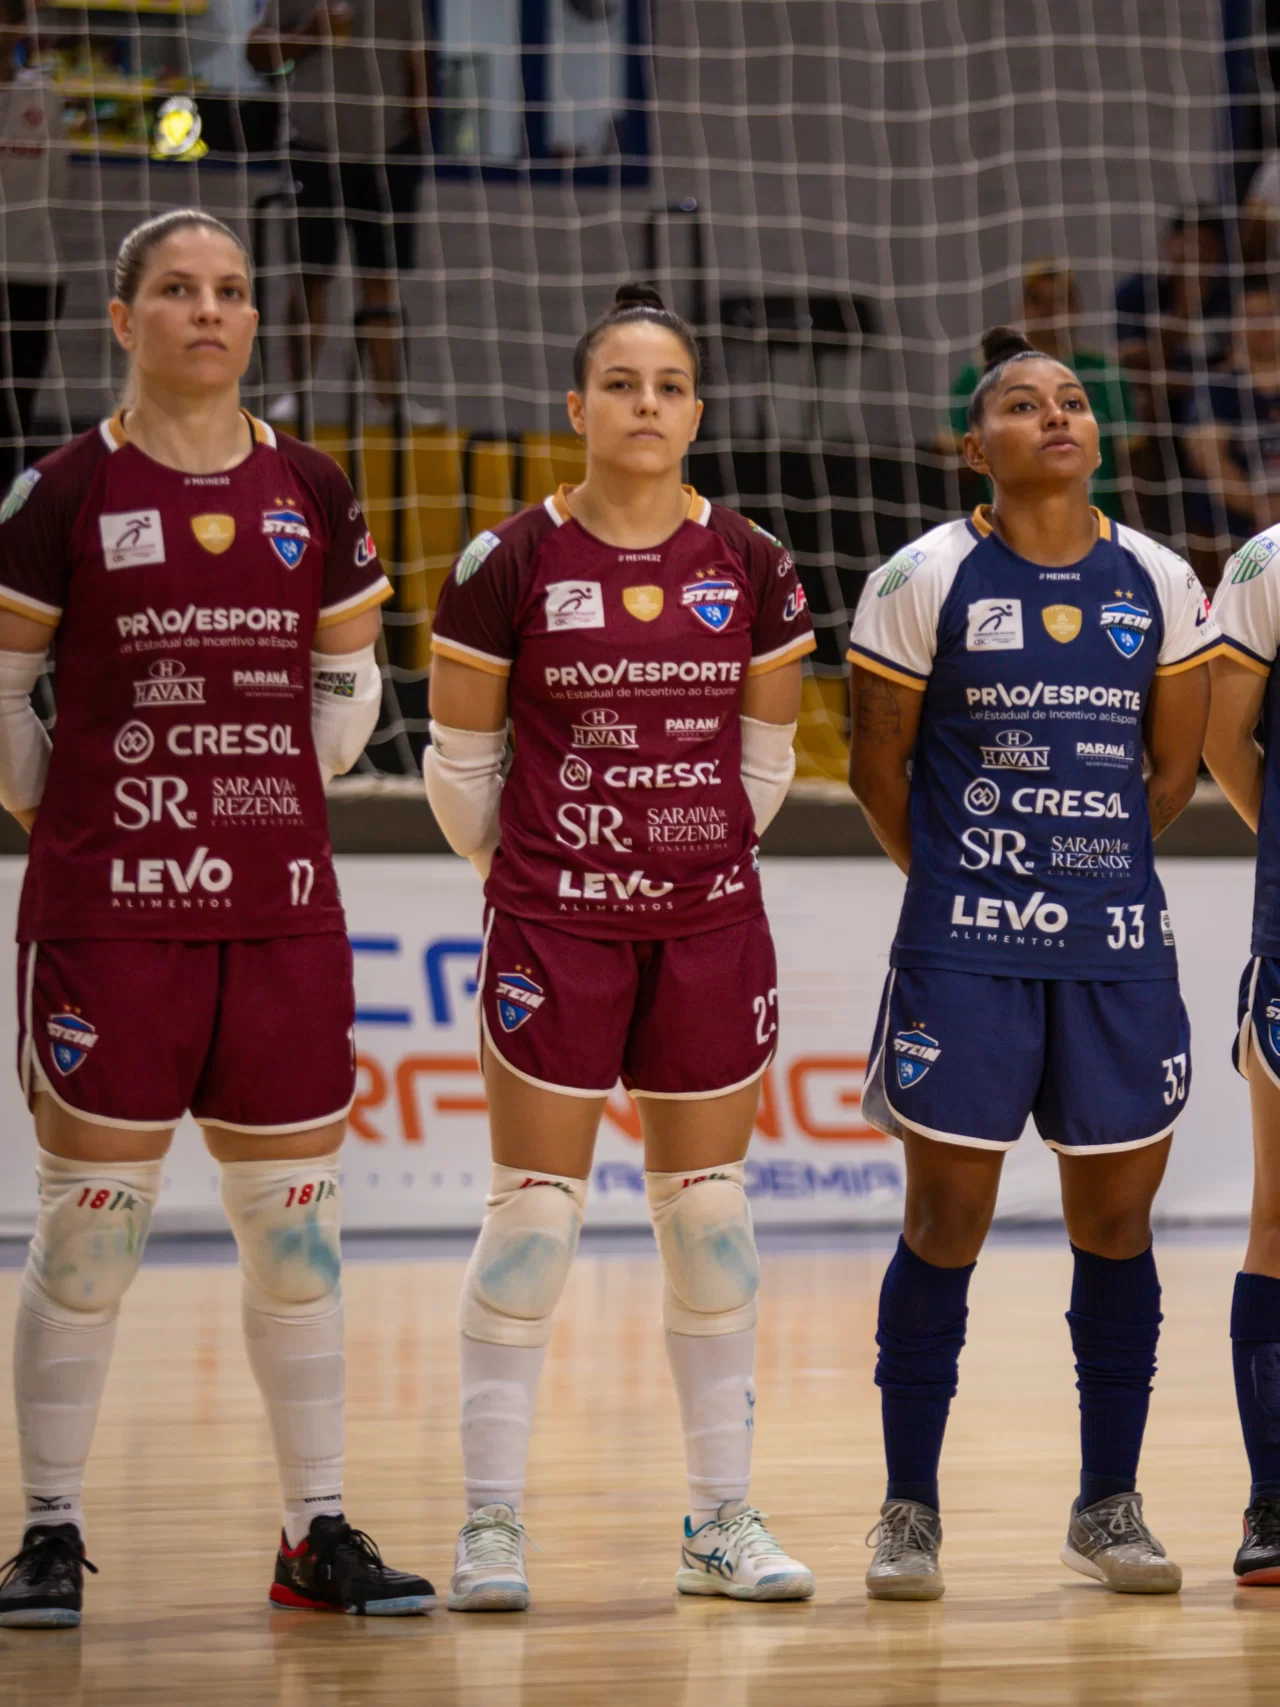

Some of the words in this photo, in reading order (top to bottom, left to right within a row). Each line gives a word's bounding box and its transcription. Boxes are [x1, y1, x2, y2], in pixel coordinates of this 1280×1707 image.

[1046, 573, 1081, 581] MEINERZ
[682, 589, 739, 605] STEIN
[1100, 611, 1152, 631] STEIN
[135, 638, 182, 653] Estadual
[185, 636, 200, 647] de
[203, 635, 255, 647] Incentivo
[269, 636, 299, 650] Espo
[232, 668, 290, 685] PARANÁ
[135, 682, 204, 704] HAVAN
[567, 688, 613, 699] Estadual
[617, 688, 630, 697] de
[633, 686, 685, 697] Incentivo
[688, 688, 702, 697] ao
[969, 710, 983, 720] Lei
[984, 710, 1029, 721] Estadual
[1032, 710, 1046, 720] de
[1050, 710, 1096, 721] Incentivo
[1110, 712, 1137, 725] Esporte
[167, 724, 301, 756] CRESOL
[573, 727, 637, 746] HAVAN
[982, 750, 1048, 767] HAVAN
[1076, 741, 1125, 757] PARANÁ
[212, 777, 290, 796] SARAIVA
[212, 797, 302, 816] REZENDE
[1012, 787, 1130, 818] CRESOL
[648, 805, 719, 825] SARAIVA
[648, 823, 729, 843] REZENDE
[1051, 836, 1121, 855] SARAIVA
[110, 847, 233, 893] LEVO
[1051, 852, 1132, 869] REZENDE
[288, 859, 314, 906] 17
[558, 870, 674, 901] LEVO
[112, 898, 233, 908] ALIMENTOS
[560, 901, 674, 912] ALIMENTOS
[951, 892, 1068, 933] LEVO
[1107, 904, 1145, 950] 33
[951, 930, 1066, 948] ALIMENTOS
[893, 1038, 942, 1063] STEIN
